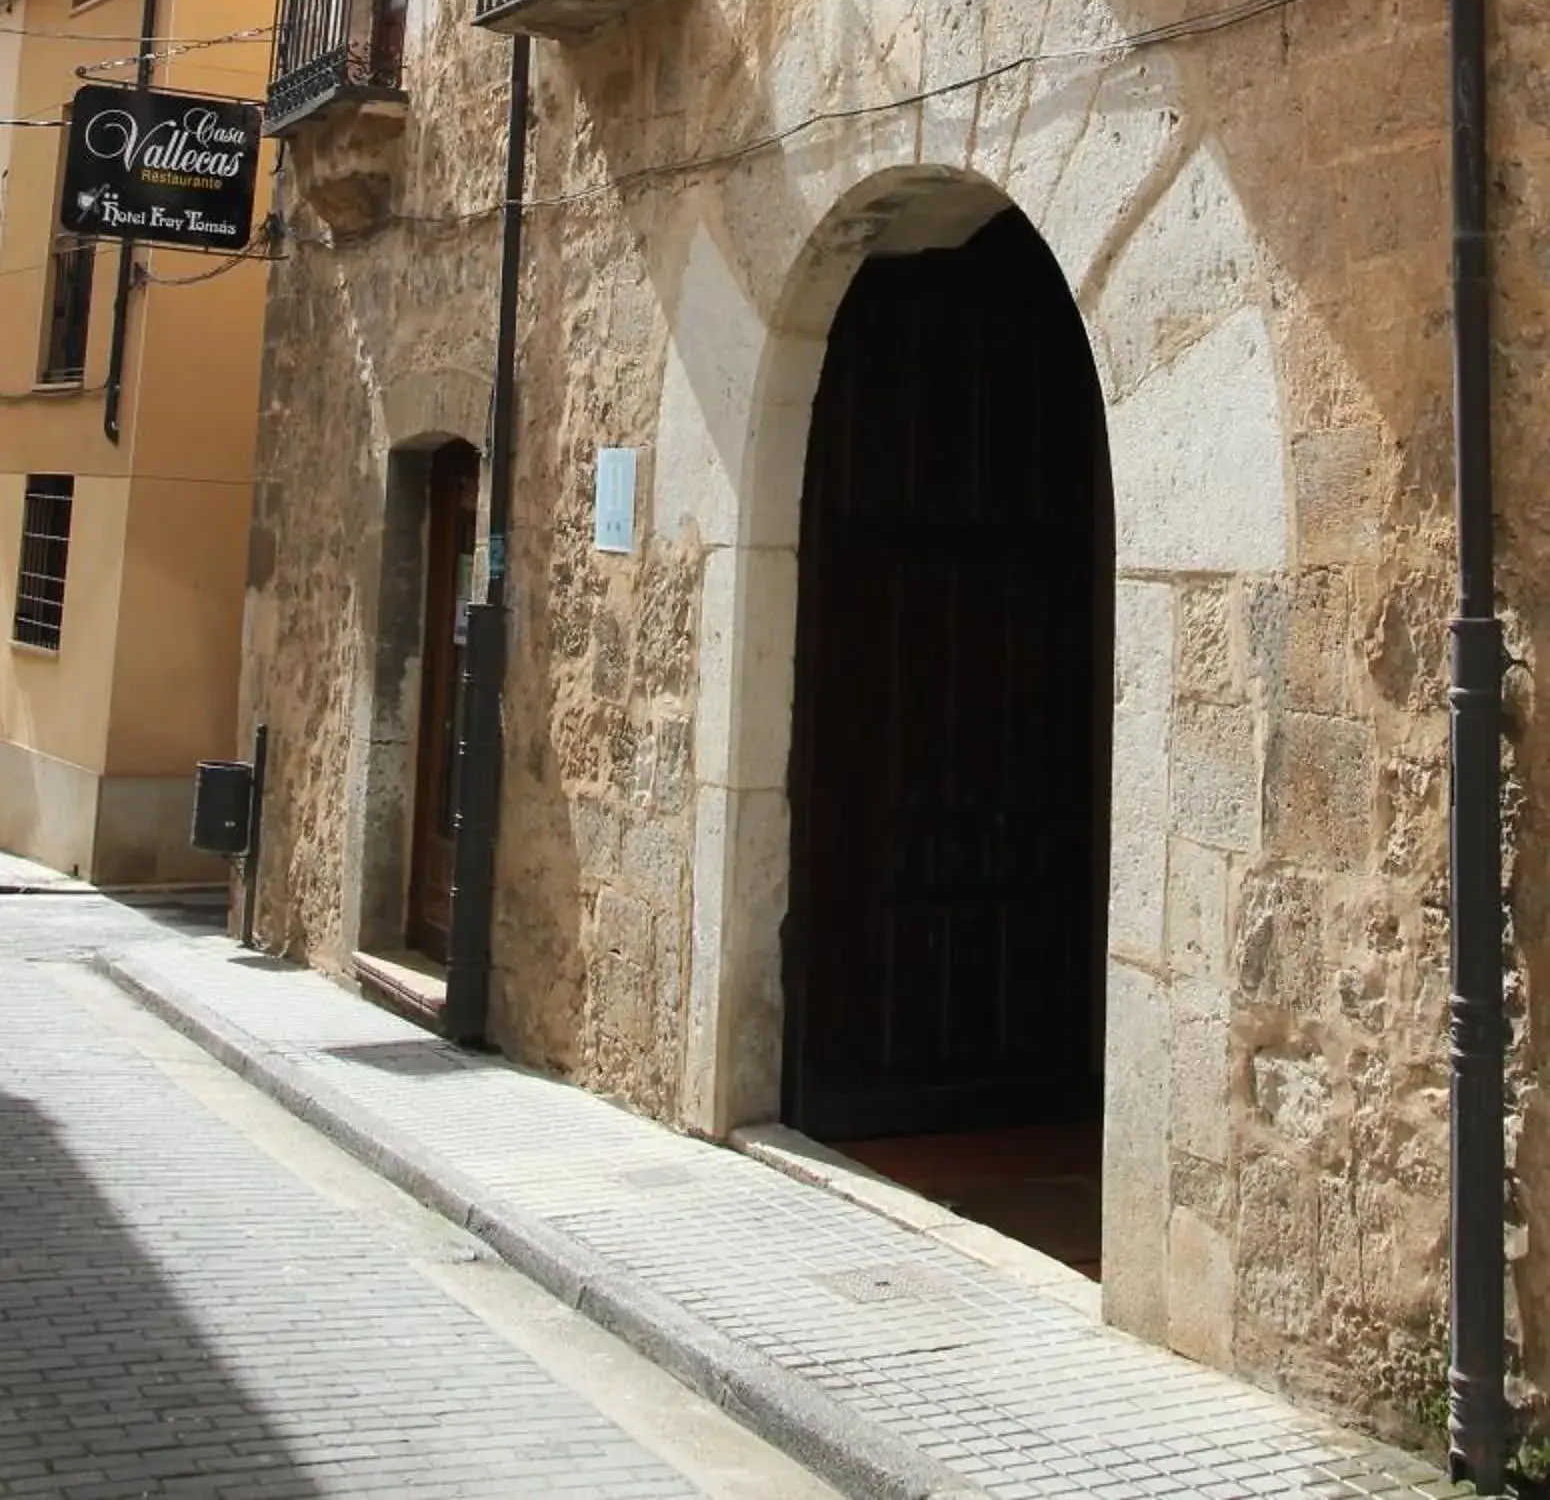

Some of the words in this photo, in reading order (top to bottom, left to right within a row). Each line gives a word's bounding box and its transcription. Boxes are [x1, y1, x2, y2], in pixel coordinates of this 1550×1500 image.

[85, 109, 244, 177] Vallecas
[184, 108, 245, 148] Casa
[141, 169, 224, 190] Restaurante
[150, 206, 184, 231] Fray
